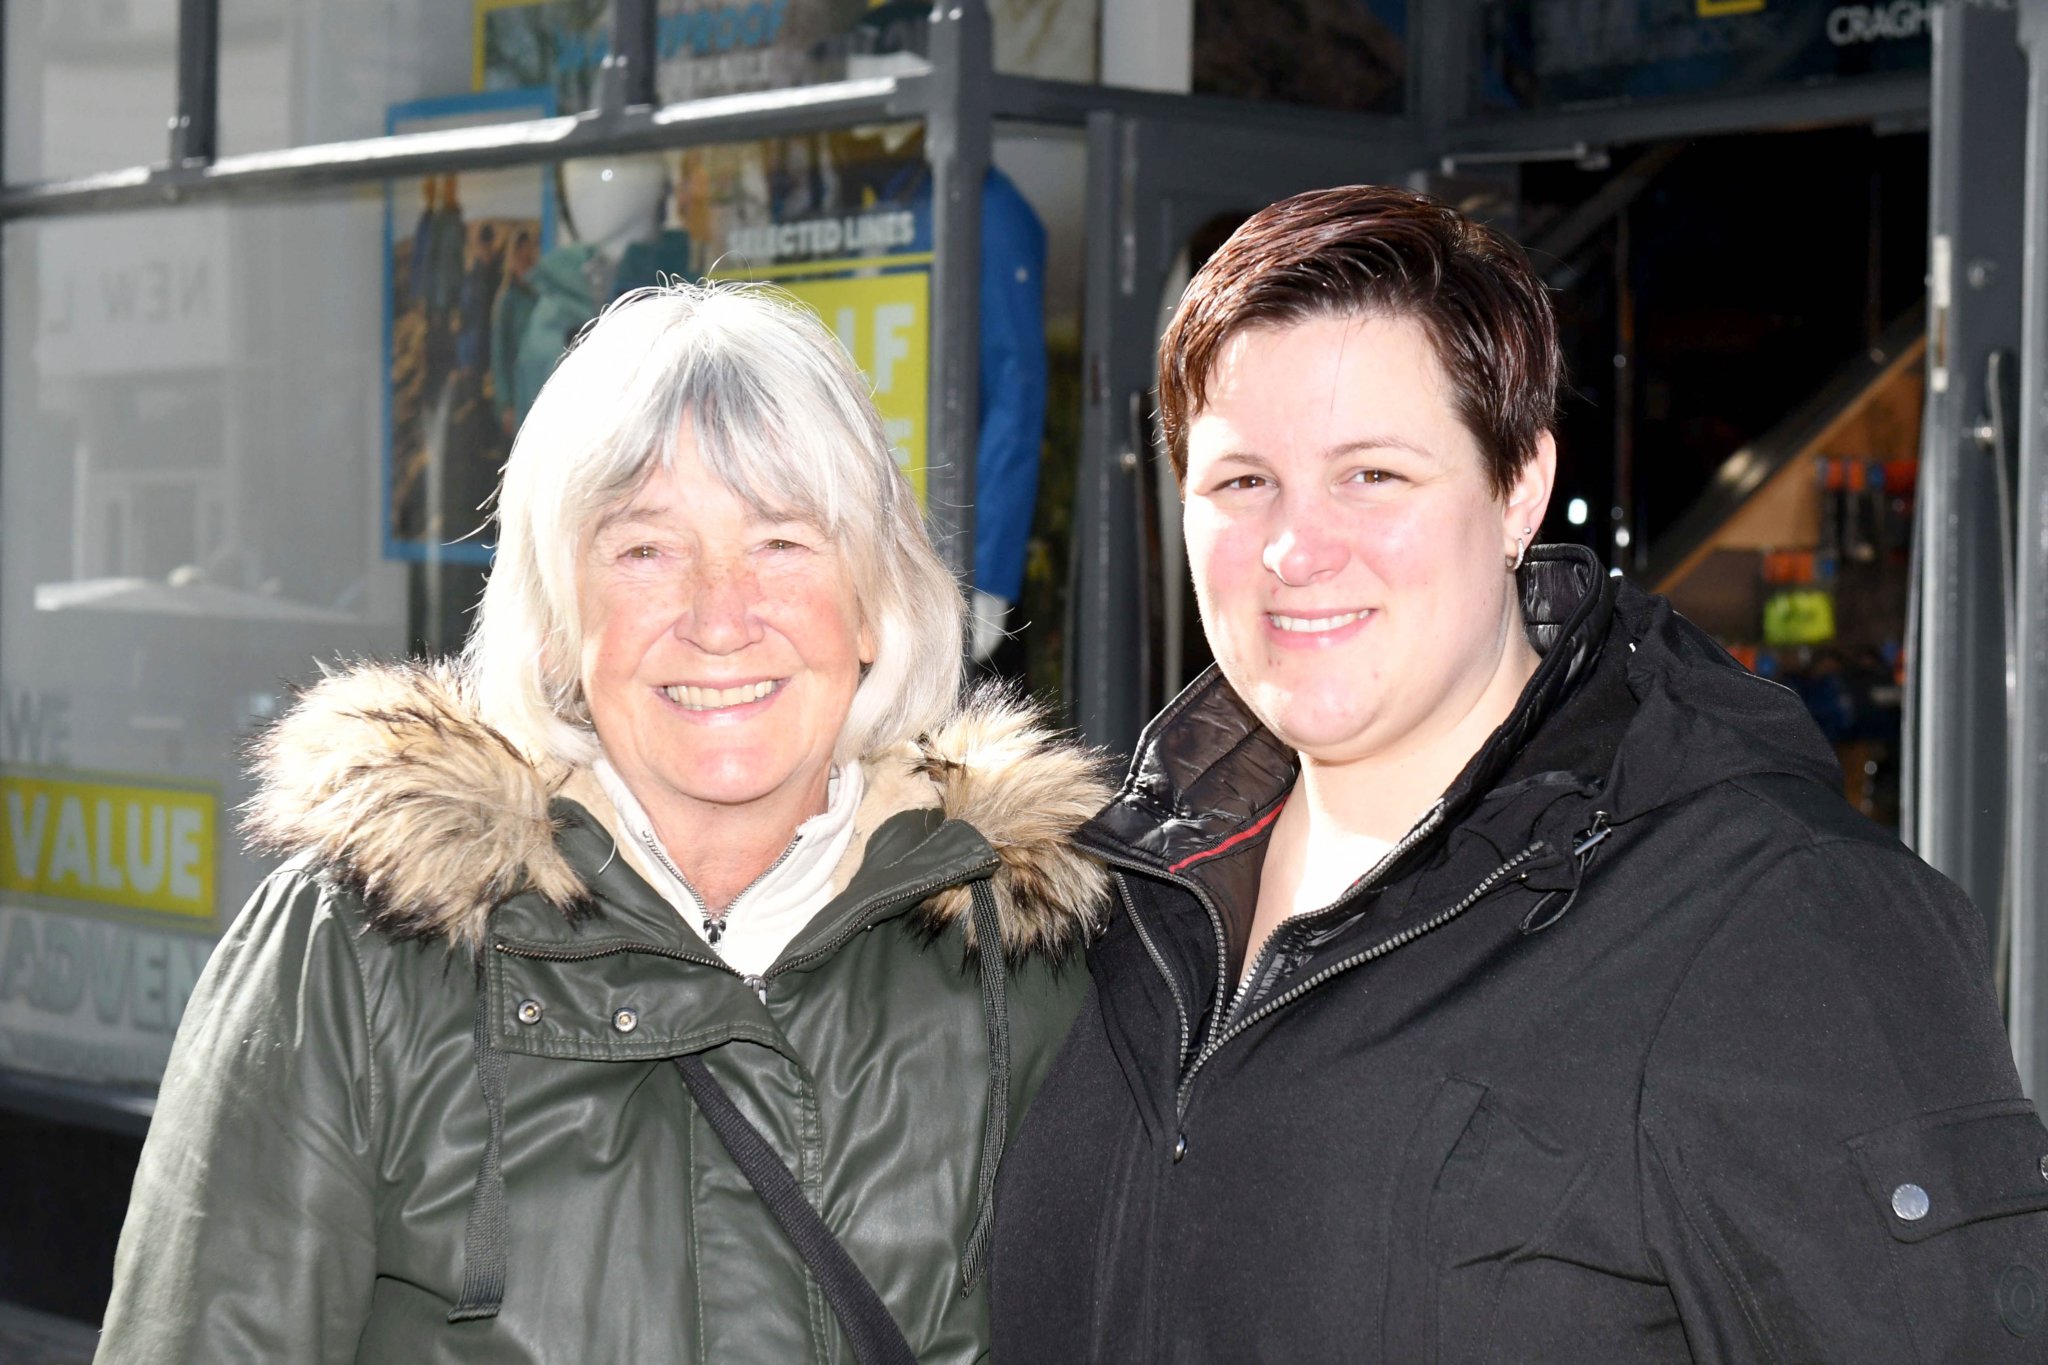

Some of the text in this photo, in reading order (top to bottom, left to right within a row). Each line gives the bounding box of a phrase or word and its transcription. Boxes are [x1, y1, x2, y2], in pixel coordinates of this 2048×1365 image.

[1826, 0, 1931, 46] CRAGH
[728, 210, 914, 260] SELECTED LINES
[7, 790, 205, 903] VALUE
[0, 915, 214, 1031] ADVEN
